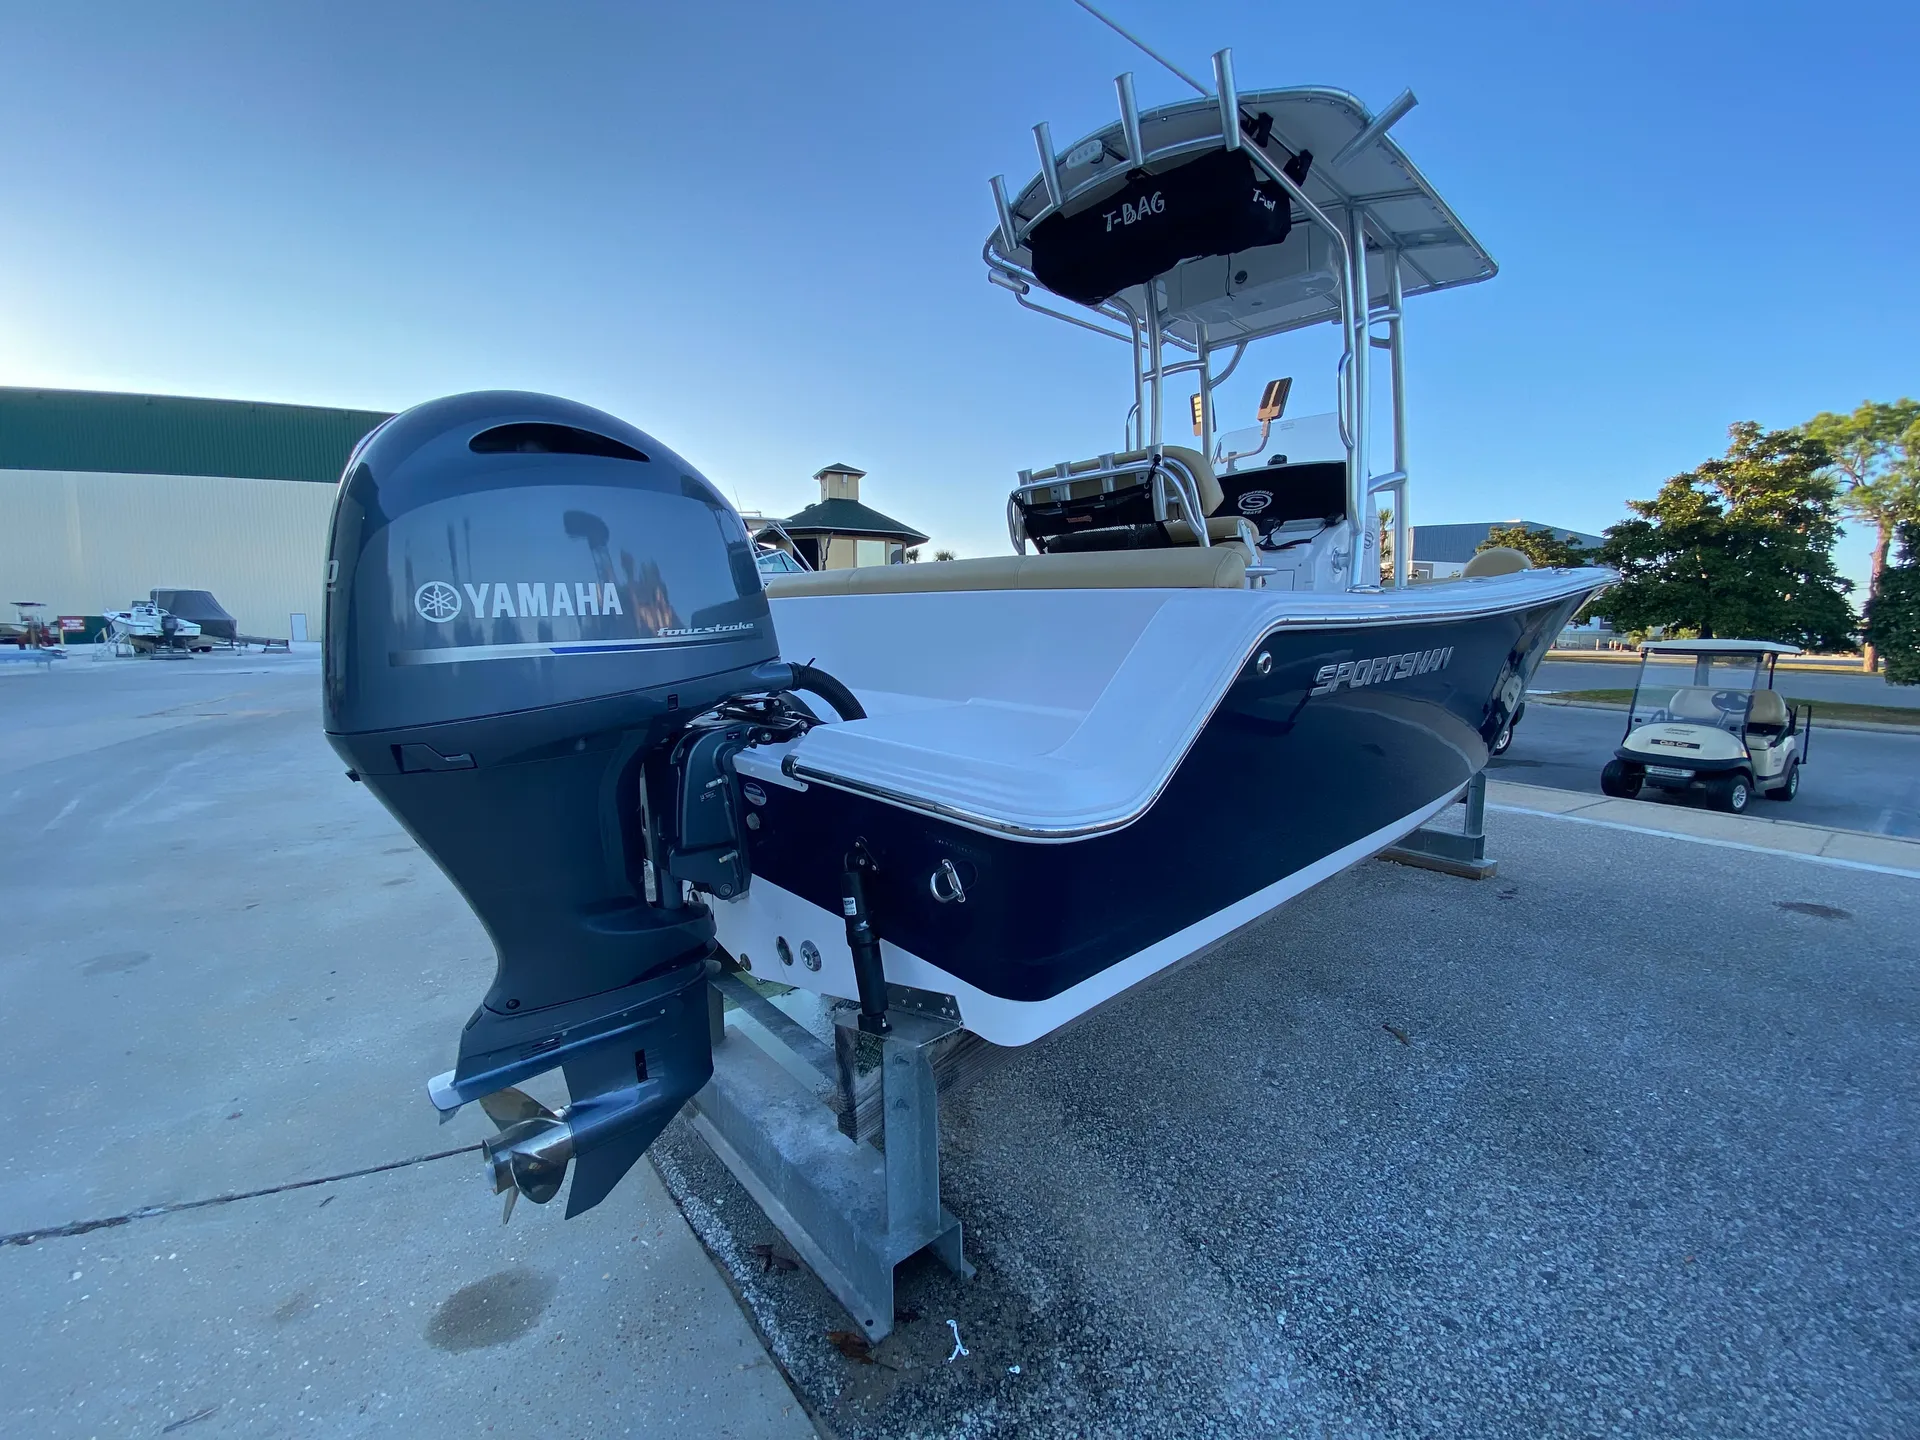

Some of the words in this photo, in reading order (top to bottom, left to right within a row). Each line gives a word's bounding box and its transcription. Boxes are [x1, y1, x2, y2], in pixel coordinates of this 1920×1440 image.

[1102, 191, 1165, 232] T-BAG
[463, 582, 623, 619] YAMAHA
[1310, 646, 1454, 697] SPORTSMAN
